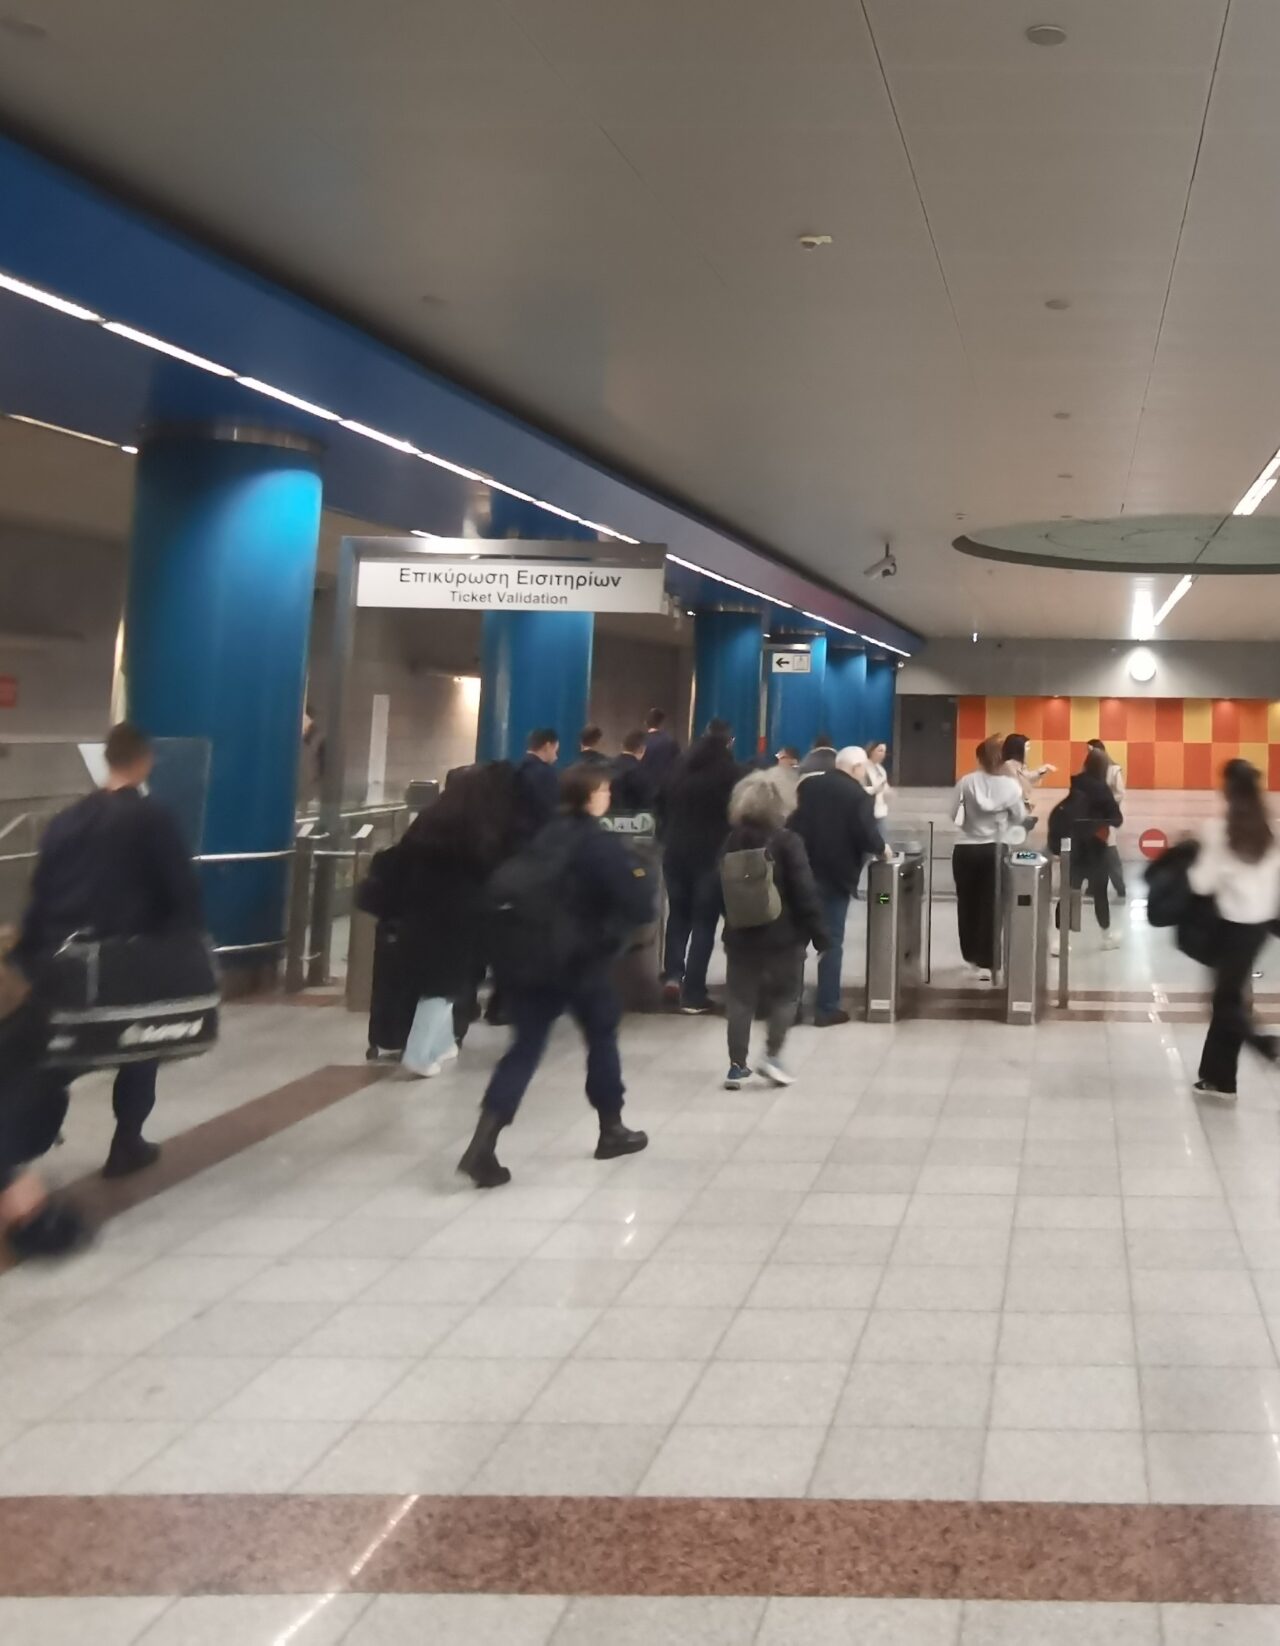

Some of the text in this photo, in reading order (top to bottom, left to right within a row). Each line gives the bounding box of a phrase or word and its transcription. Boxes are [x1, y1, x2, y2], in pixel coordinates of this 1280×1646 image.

[399, 567, 622, 590] Επικύρωση Εισιτηρίων
[450, 590, 568, 605] Ticket Validation
